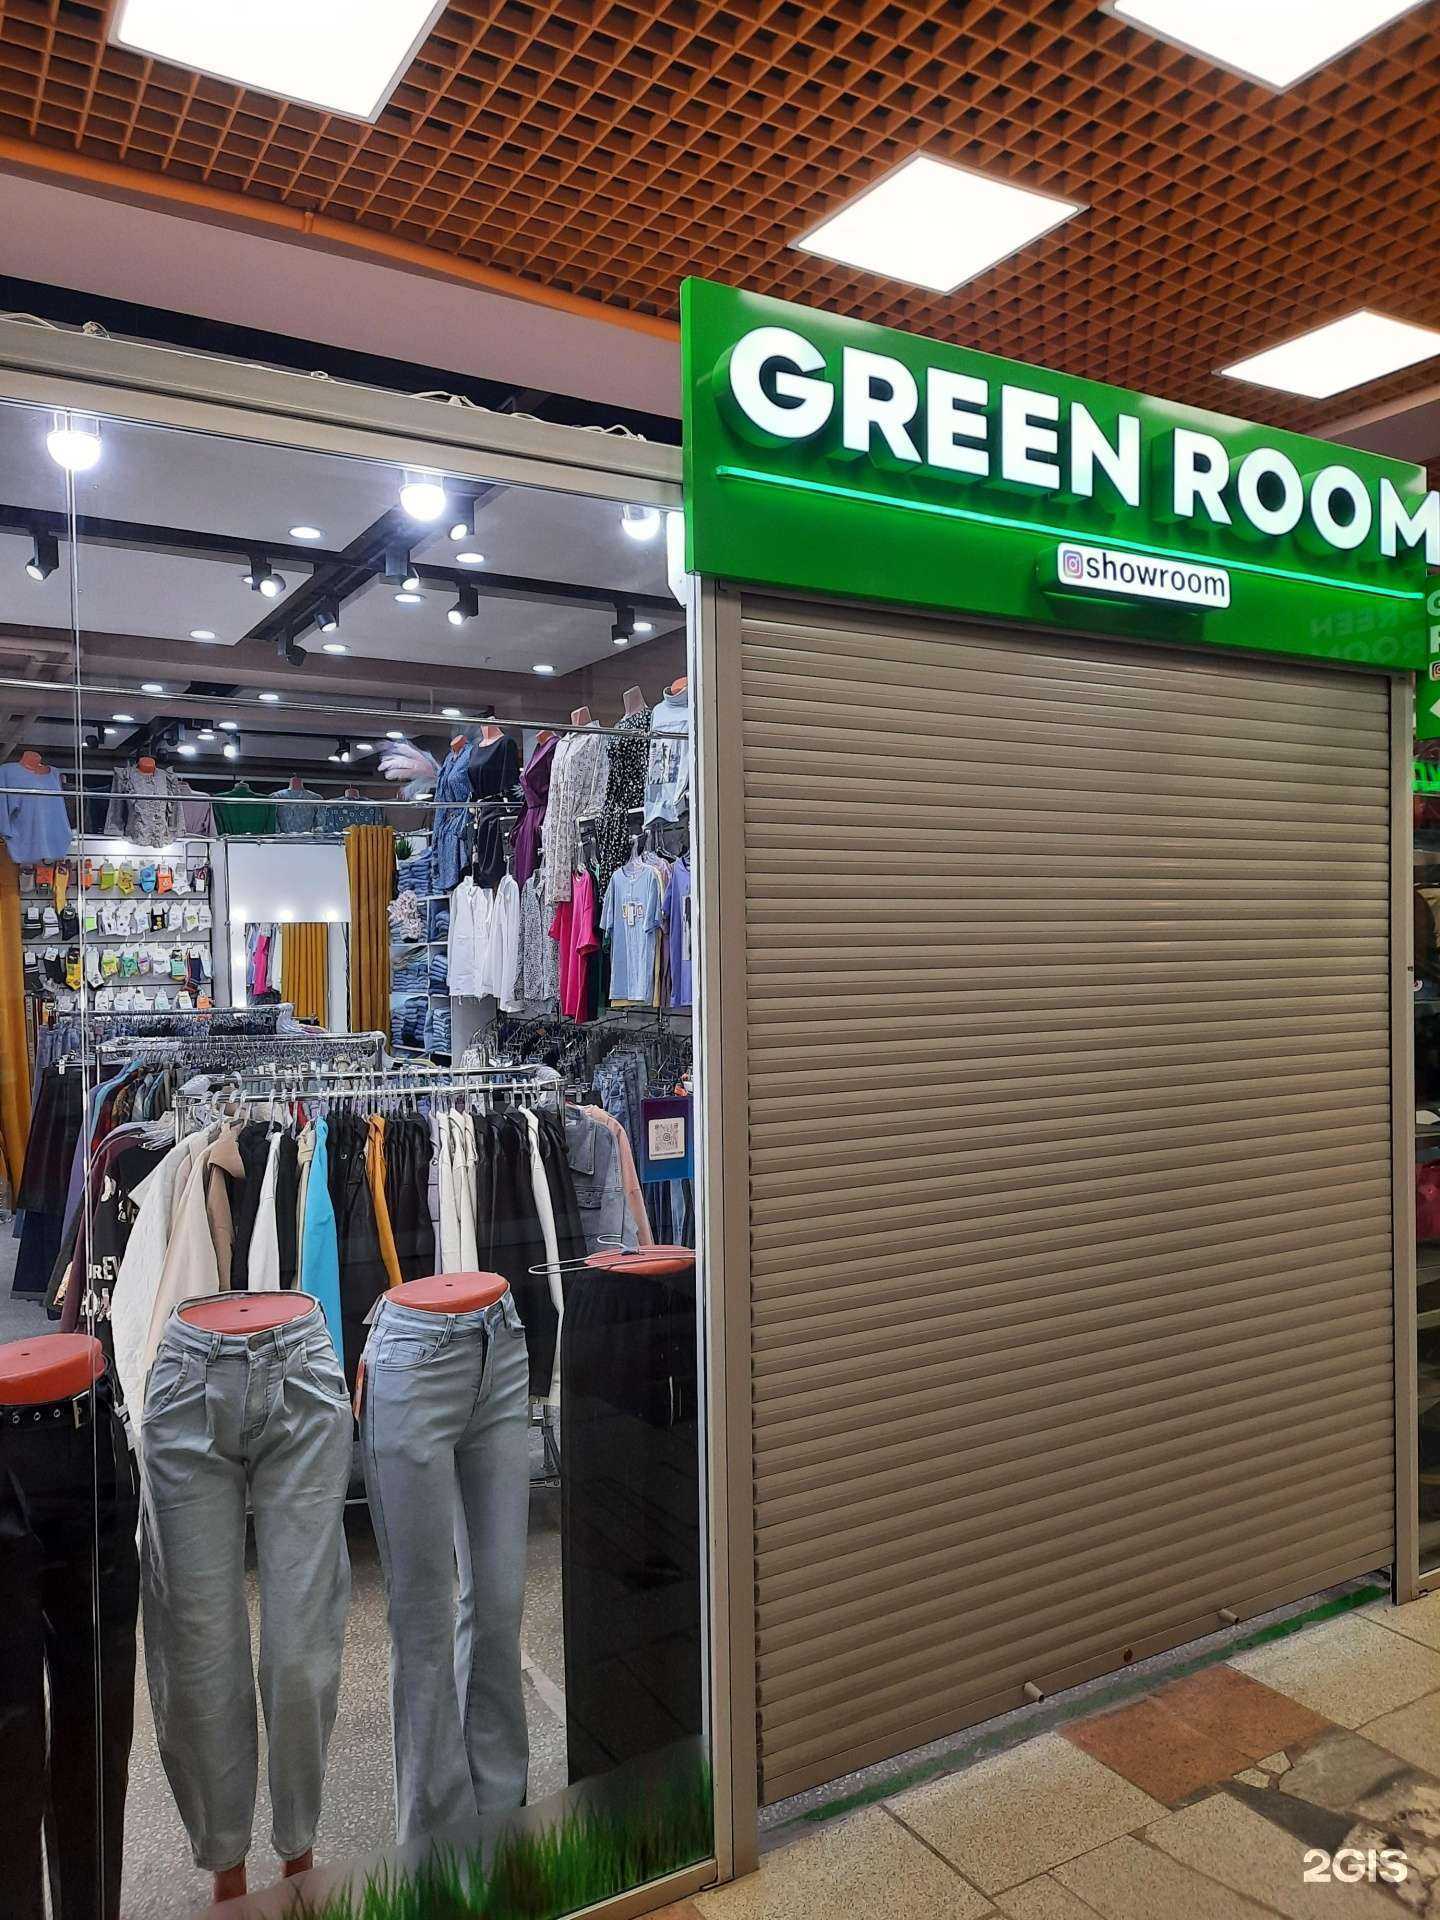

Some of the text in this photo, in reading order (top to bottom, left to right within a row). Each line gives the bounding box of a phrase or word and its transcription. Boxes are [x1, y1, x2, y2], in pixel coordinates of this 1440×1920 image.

[729, 326, 1440, 567] GREEN ROOM
[1086, 552, 1226, 598] showroom
